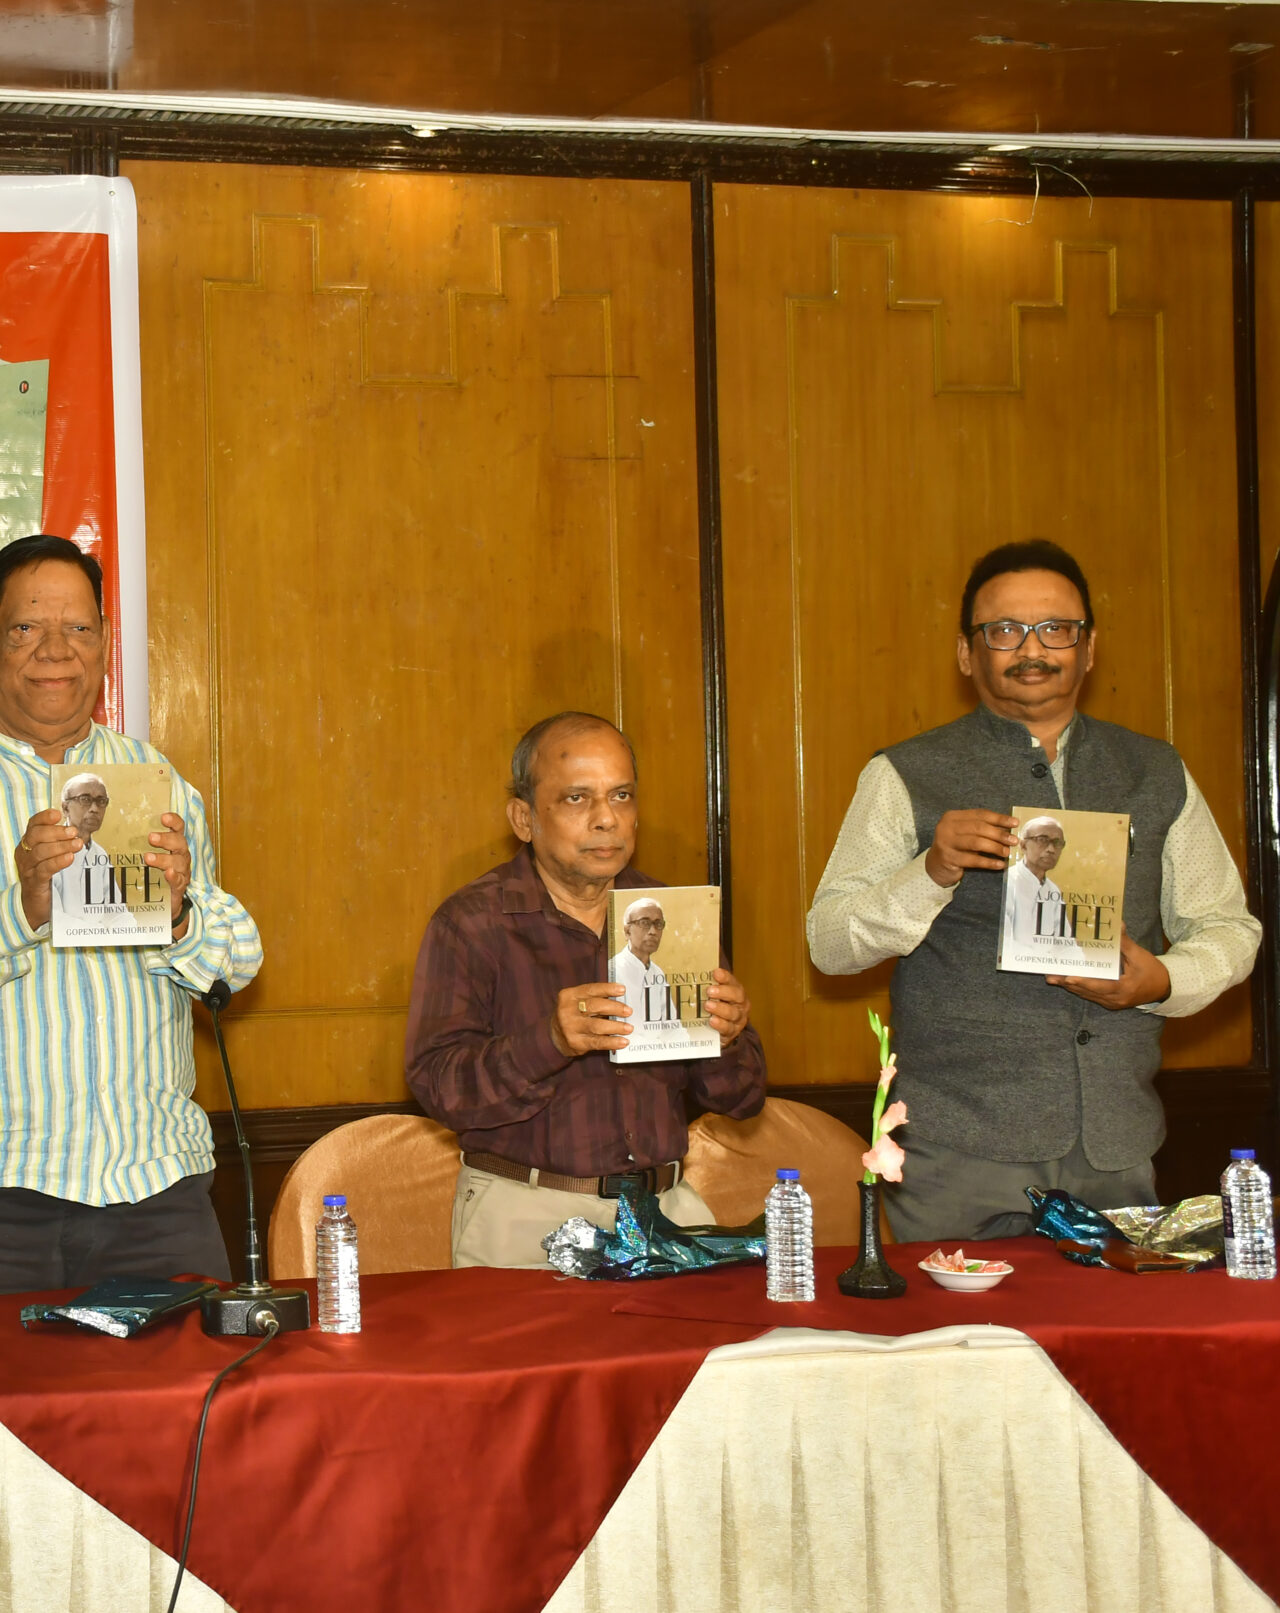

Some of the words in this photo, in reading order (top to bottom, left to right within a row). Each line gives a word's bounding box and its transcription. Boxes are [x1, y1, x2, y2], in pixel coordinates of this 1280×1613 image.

[83, 866, 164, 905] LIFE
[1045, 891, 1096, 904] JOURNEY
[1101, 894, 1118, 906] OF
[83, 906, 103, 914] WITH
[104, 906, 125, 914] DIVINE
[128, 905, 165, 913] BLESSINGS
[1033, 902, 1115, 941] LIFE
[66, 927, 110, 936] GOPENDRA
[112, 926, 147, 934] KISHORE
[149, 925, 165, 934] ROY
[1032, 937, 1053, 945] WITH
[1015, 955, 1058, 965] GOPENDRA
[1060, 959, 1095, 968] KISHORE
[651, 972, 696, 985] JOURNEY
[644, 983, 713, 1022] LIFE
[643, 1023, 661, 1031] WITH
[629, 1043, 667, 1052] GOPENDRA
